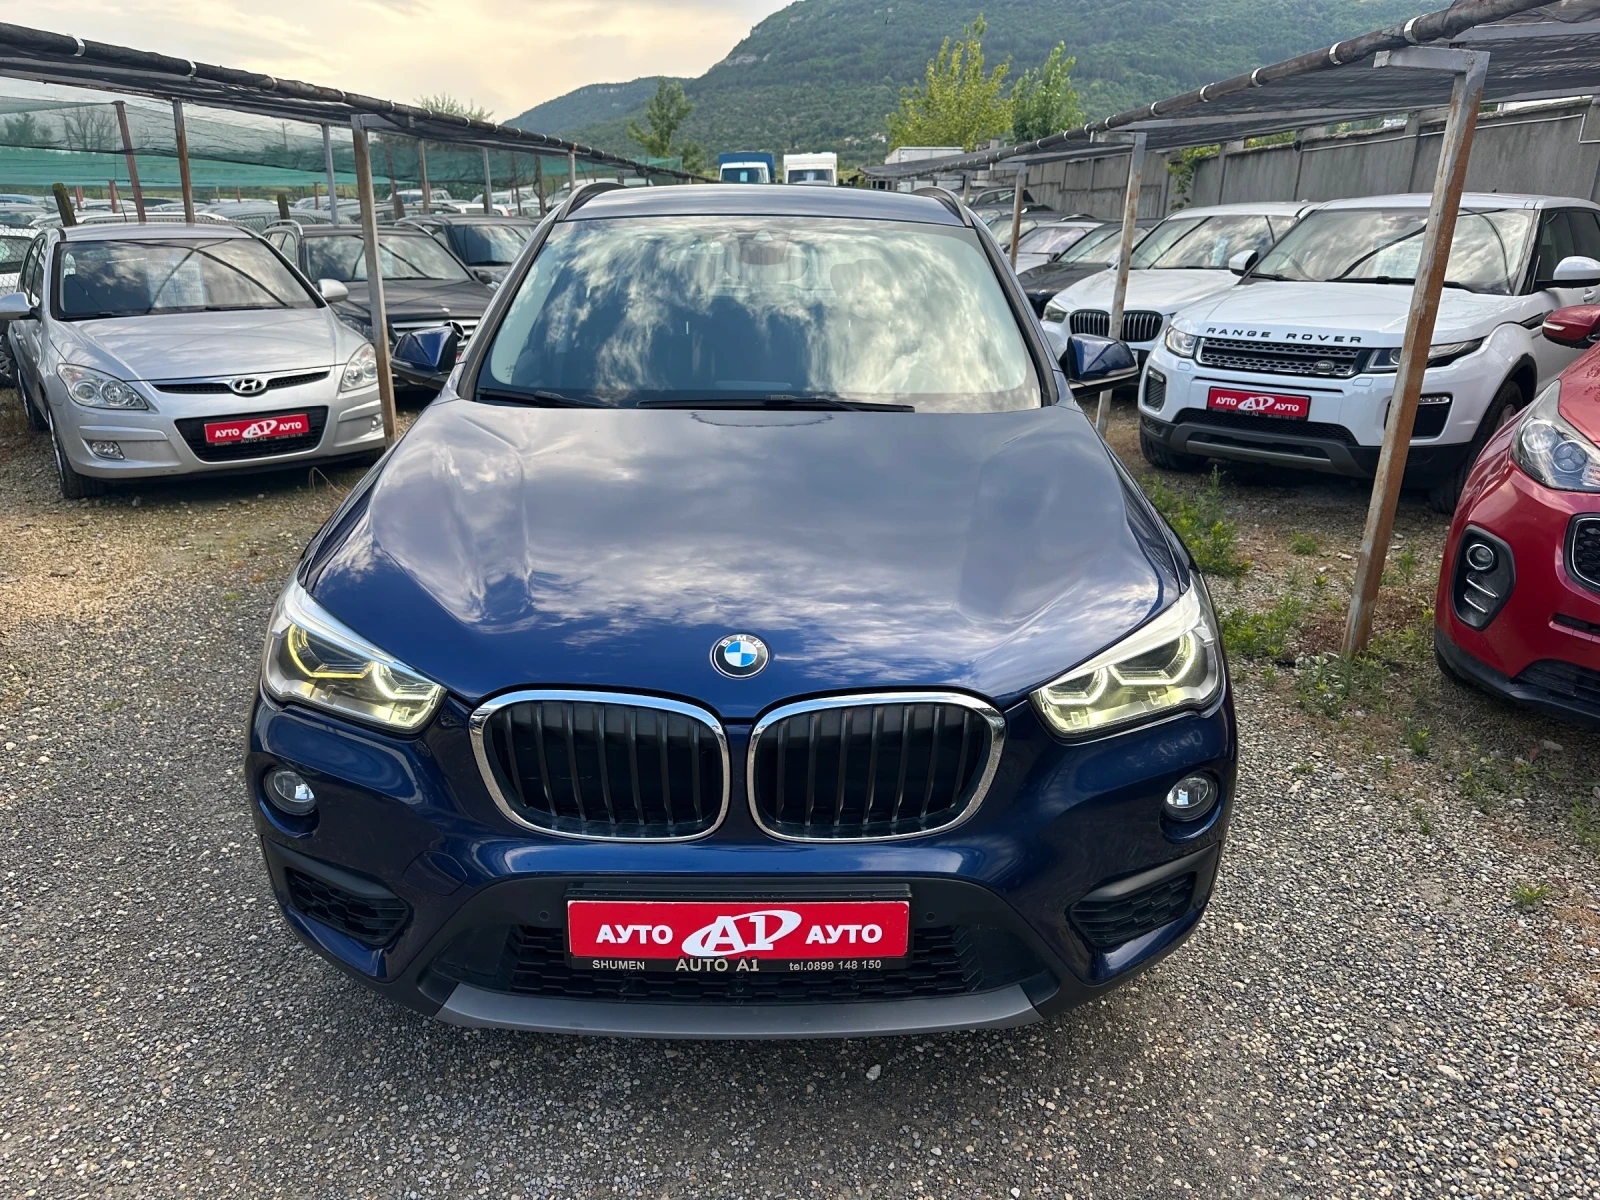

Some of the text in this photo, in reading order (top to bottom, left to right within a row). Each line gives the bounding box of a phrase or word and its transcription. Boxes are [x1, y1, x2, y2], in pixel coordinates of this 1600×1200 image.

[1206, 327, 1362, 343] RANGE ROVER
[1215, 396, 1237, 406] АУТО
[1274, 403, 1300, 412] АУТО
[215, 428, 240, 438] АУТО
[279, 421, 302, 431] АУТО
[719, 634, 764, 648] BMW
[595, 924, 674, 945] АУТО
[805, 923, 883, 944] АУТО
[592, 958, 882, 972] SHUMEN AUTO A1 tel.0899 148 150
